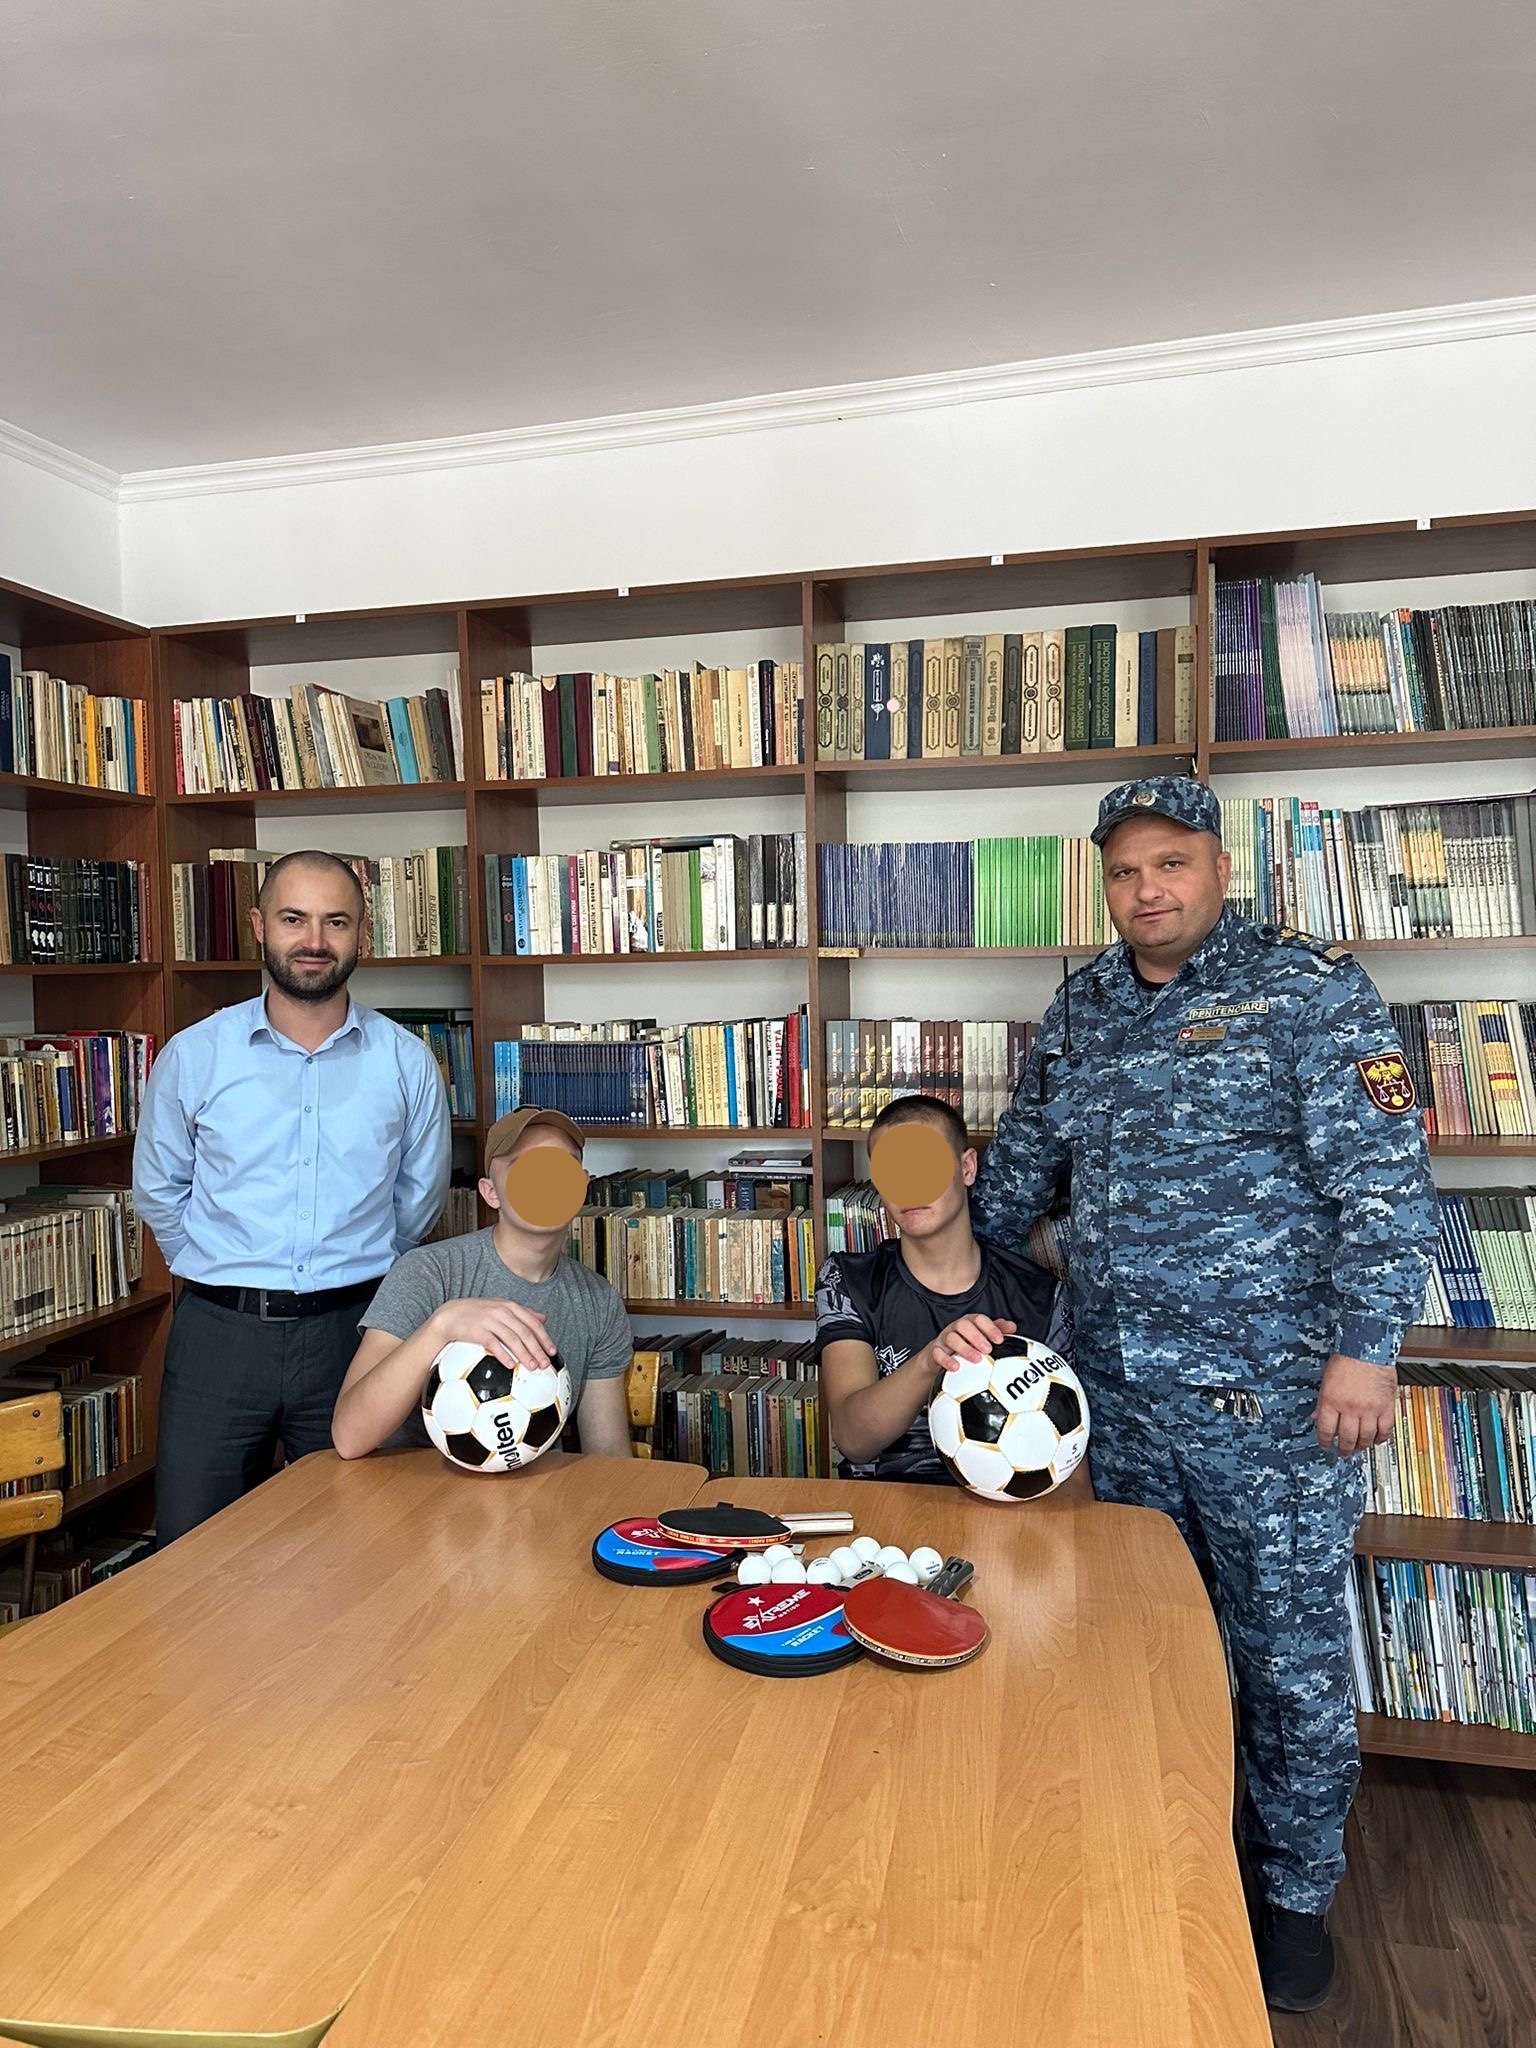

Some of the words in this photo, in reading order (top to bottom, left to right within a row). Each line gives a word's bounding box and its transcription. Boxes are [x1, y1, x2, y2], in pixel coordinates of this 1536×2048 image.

[1077, 688, 1086, 738] ORTOGRAFIC
[1102, 686, 1110, 736] ORTOGRAFIC
[1192, 1003, 1266, 1019] PENITENCIARE
[1006, 1354, 1066, 1401] molten
[1072, 1443, 1078, 1455] 5
[790, 1625, 825, 1648] RACKET
